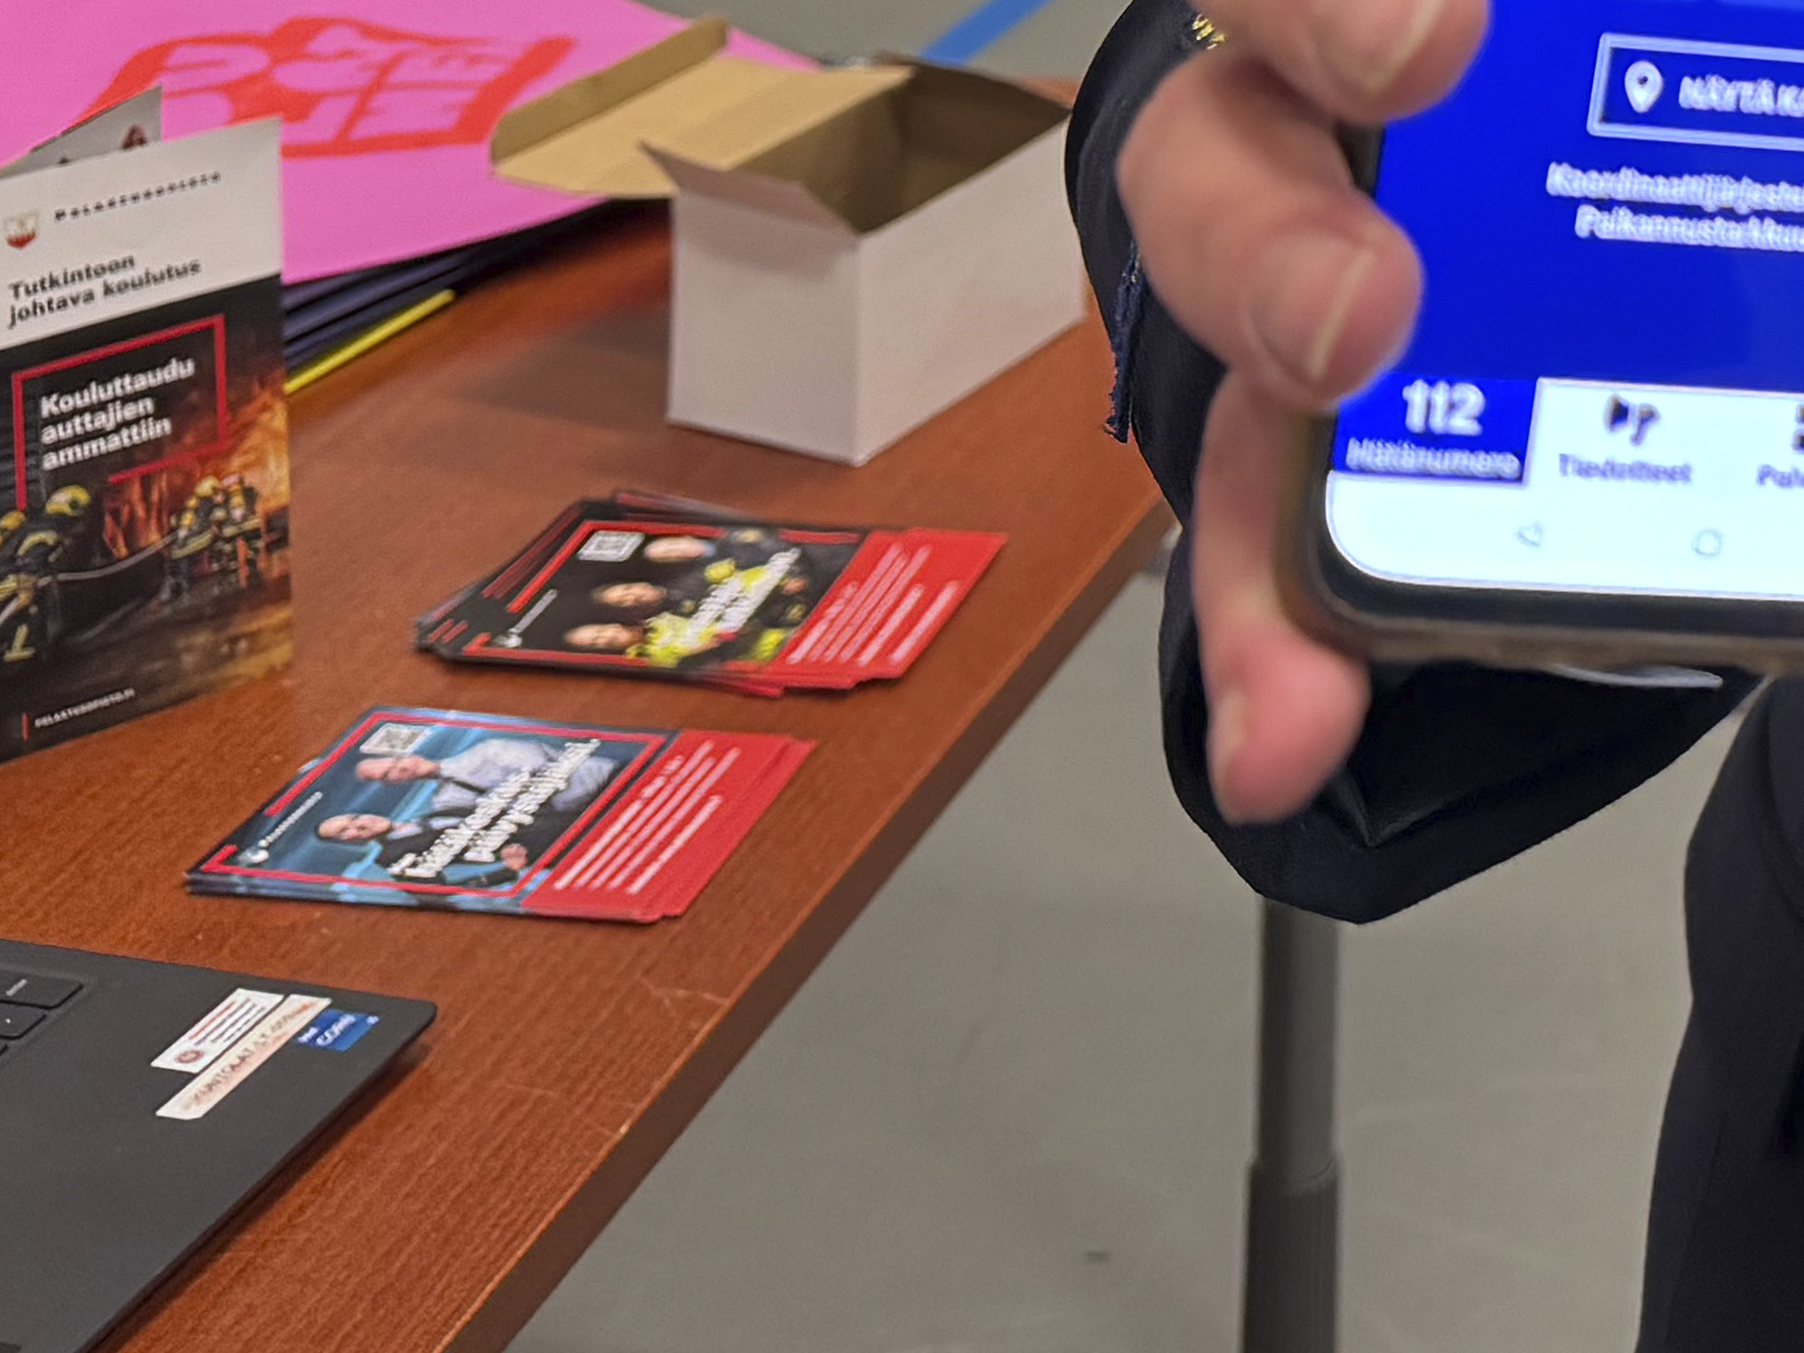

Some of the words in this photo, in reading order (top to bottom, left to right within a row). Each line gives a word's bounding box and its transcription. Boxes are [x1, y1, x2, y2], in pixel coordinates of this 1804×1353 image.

[8, 255, 136, 300] Tutkintoon
[8, 289, 95, 329] johtava
[103, 259, 202, 298] koulutus
[40, 357, 195, 418] Kouluttaudu
[1402, 379, 1486, 436] 112
[41, 396, 155, 444] auttajien
[41, 417, 173, 471] ammattiin
